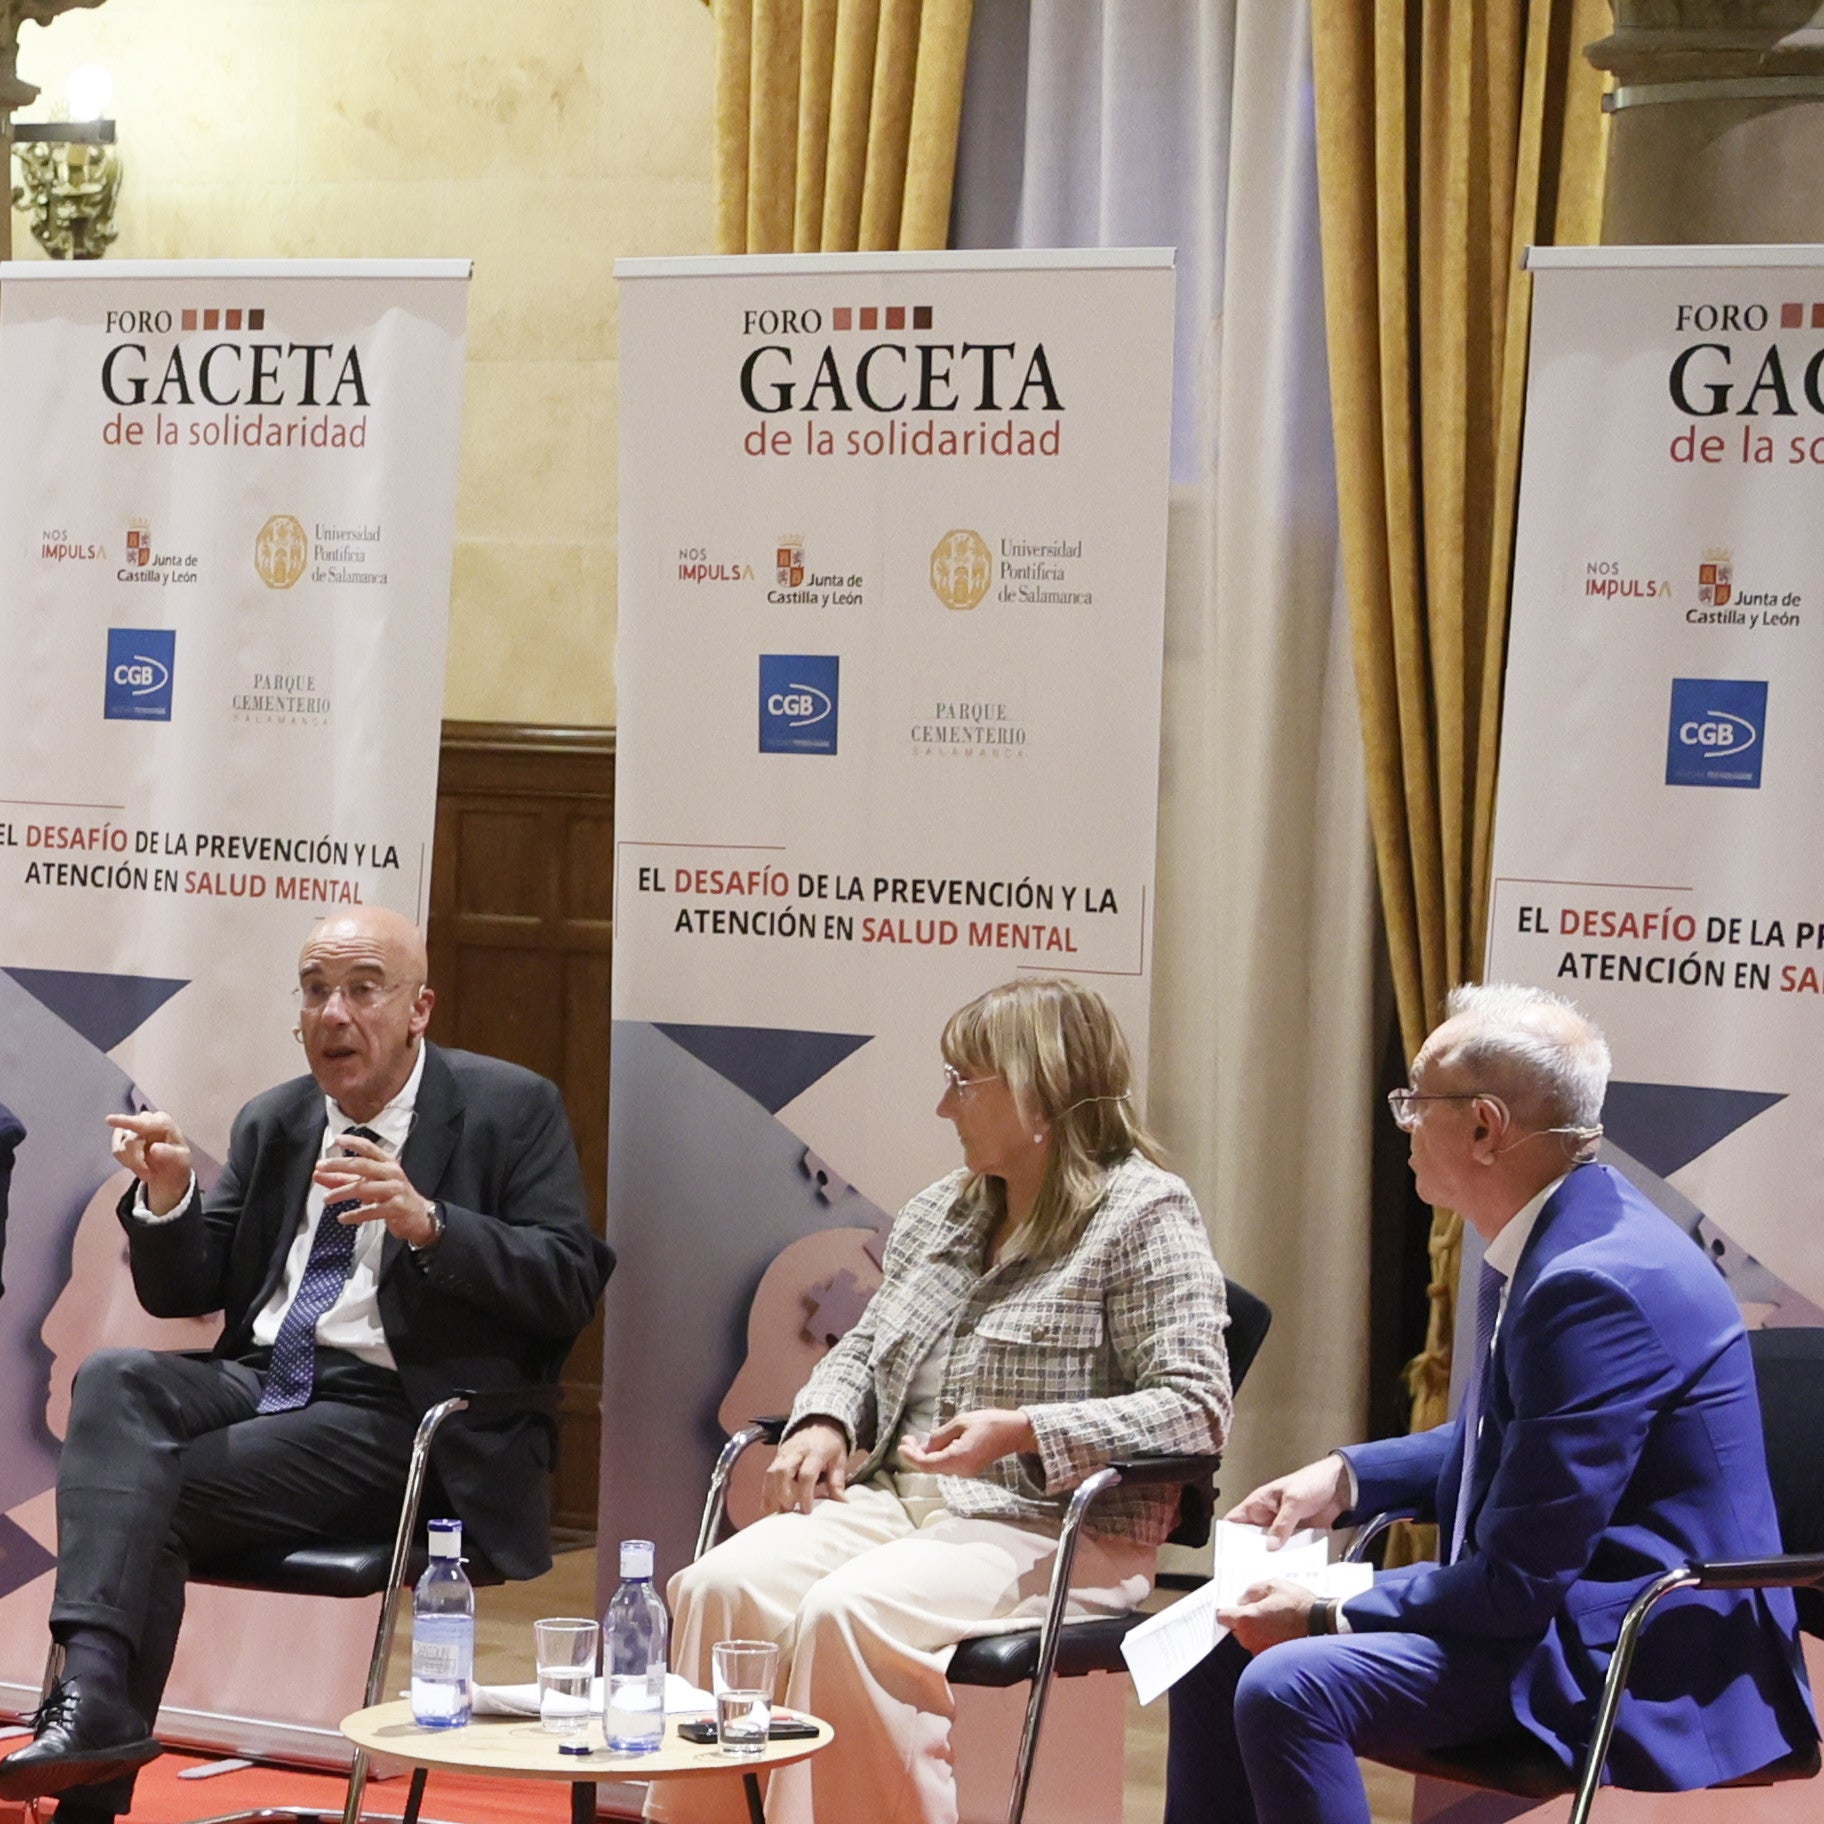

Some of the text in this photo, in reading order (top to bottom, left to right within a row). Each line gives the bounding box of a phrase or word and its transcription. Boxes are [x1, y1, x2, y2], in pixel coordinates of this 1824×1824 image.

[105, 310, 172, 334] FORO
[743, 309, 822, 335] FORO
[1675, 304, 1768, 332] FORO
[101, 342, 371, 407] GACETA
[739, 342, 1066, 414] GACETA
[102, 413, 367, 448] de la solidaridad
[744, 420, 1061, 457] de la solidaridad
[1669, 424, 1726, 464] de
[1743, 425, 1774, 464] la
[42, 530, 68, 541] NOS
[315, 524, 380, 542] Universidad
[314, 545, 366, 563] Pontificia
[679, 548, 707, 560] NOS
[1000, 539, 1082, 558] Universidad
[151, 553, 198, 568] Junta de
[1587, 562, 1619, 575] NOS
[117, 569, 198, 587] Castilla y León
[311, 567, 388, 585] de Salamanca
[806, 572, 863, 589] Junta de
[1000, 562, 1065, 581] Pontificia
[767, 590, 863, 608] Castilla y León
[997, 587, 1093, 605] de Salamanca
[1734, 591, 1802, 607] Junta de
[1686, 608, 1800, 629] Castilla y León
[113, 665, 153, 686] CGB
[253, 674, 316, 692] PARQUE
[232, 694, 331, 714] CEMENTERIO
[767, 694, 813, 716] CGB
[936, 702, 1007, 721] PARQUE
[911, 726, 1027, 745] CEMENTERIO
[1679, 721, 1734, 746] CGB
[25, 821, 127, 853] DESAFÍO
[135, 830, 159, 856] DE
[164, 831, 189, 856] LA
[195, 831, 349, 866] PREVENCIÓN
[354, 841, 368, 867] Y
[371, 842, 399, 870] LA
[24, 859, 363, 906] ATENCIÓN EN SALUD MENTAL
[638, 865, 1119, 915] EL DESAFÍO DE LA PREVENCIÓN Y LA
[674, 906, 1079, 953] ATENCIÓN EN SALUD MENTAL
[1518, 906, 1549, 934] EL
[1559, 906, 1696, 942] DESAFÍO
[1706, 916, 1743, 944] DE
[1751, 918, 1787, 946] LA
[1557, 950, 1726, 988] ATENCIÓN
[1734, 963, 1770, 990] EN
